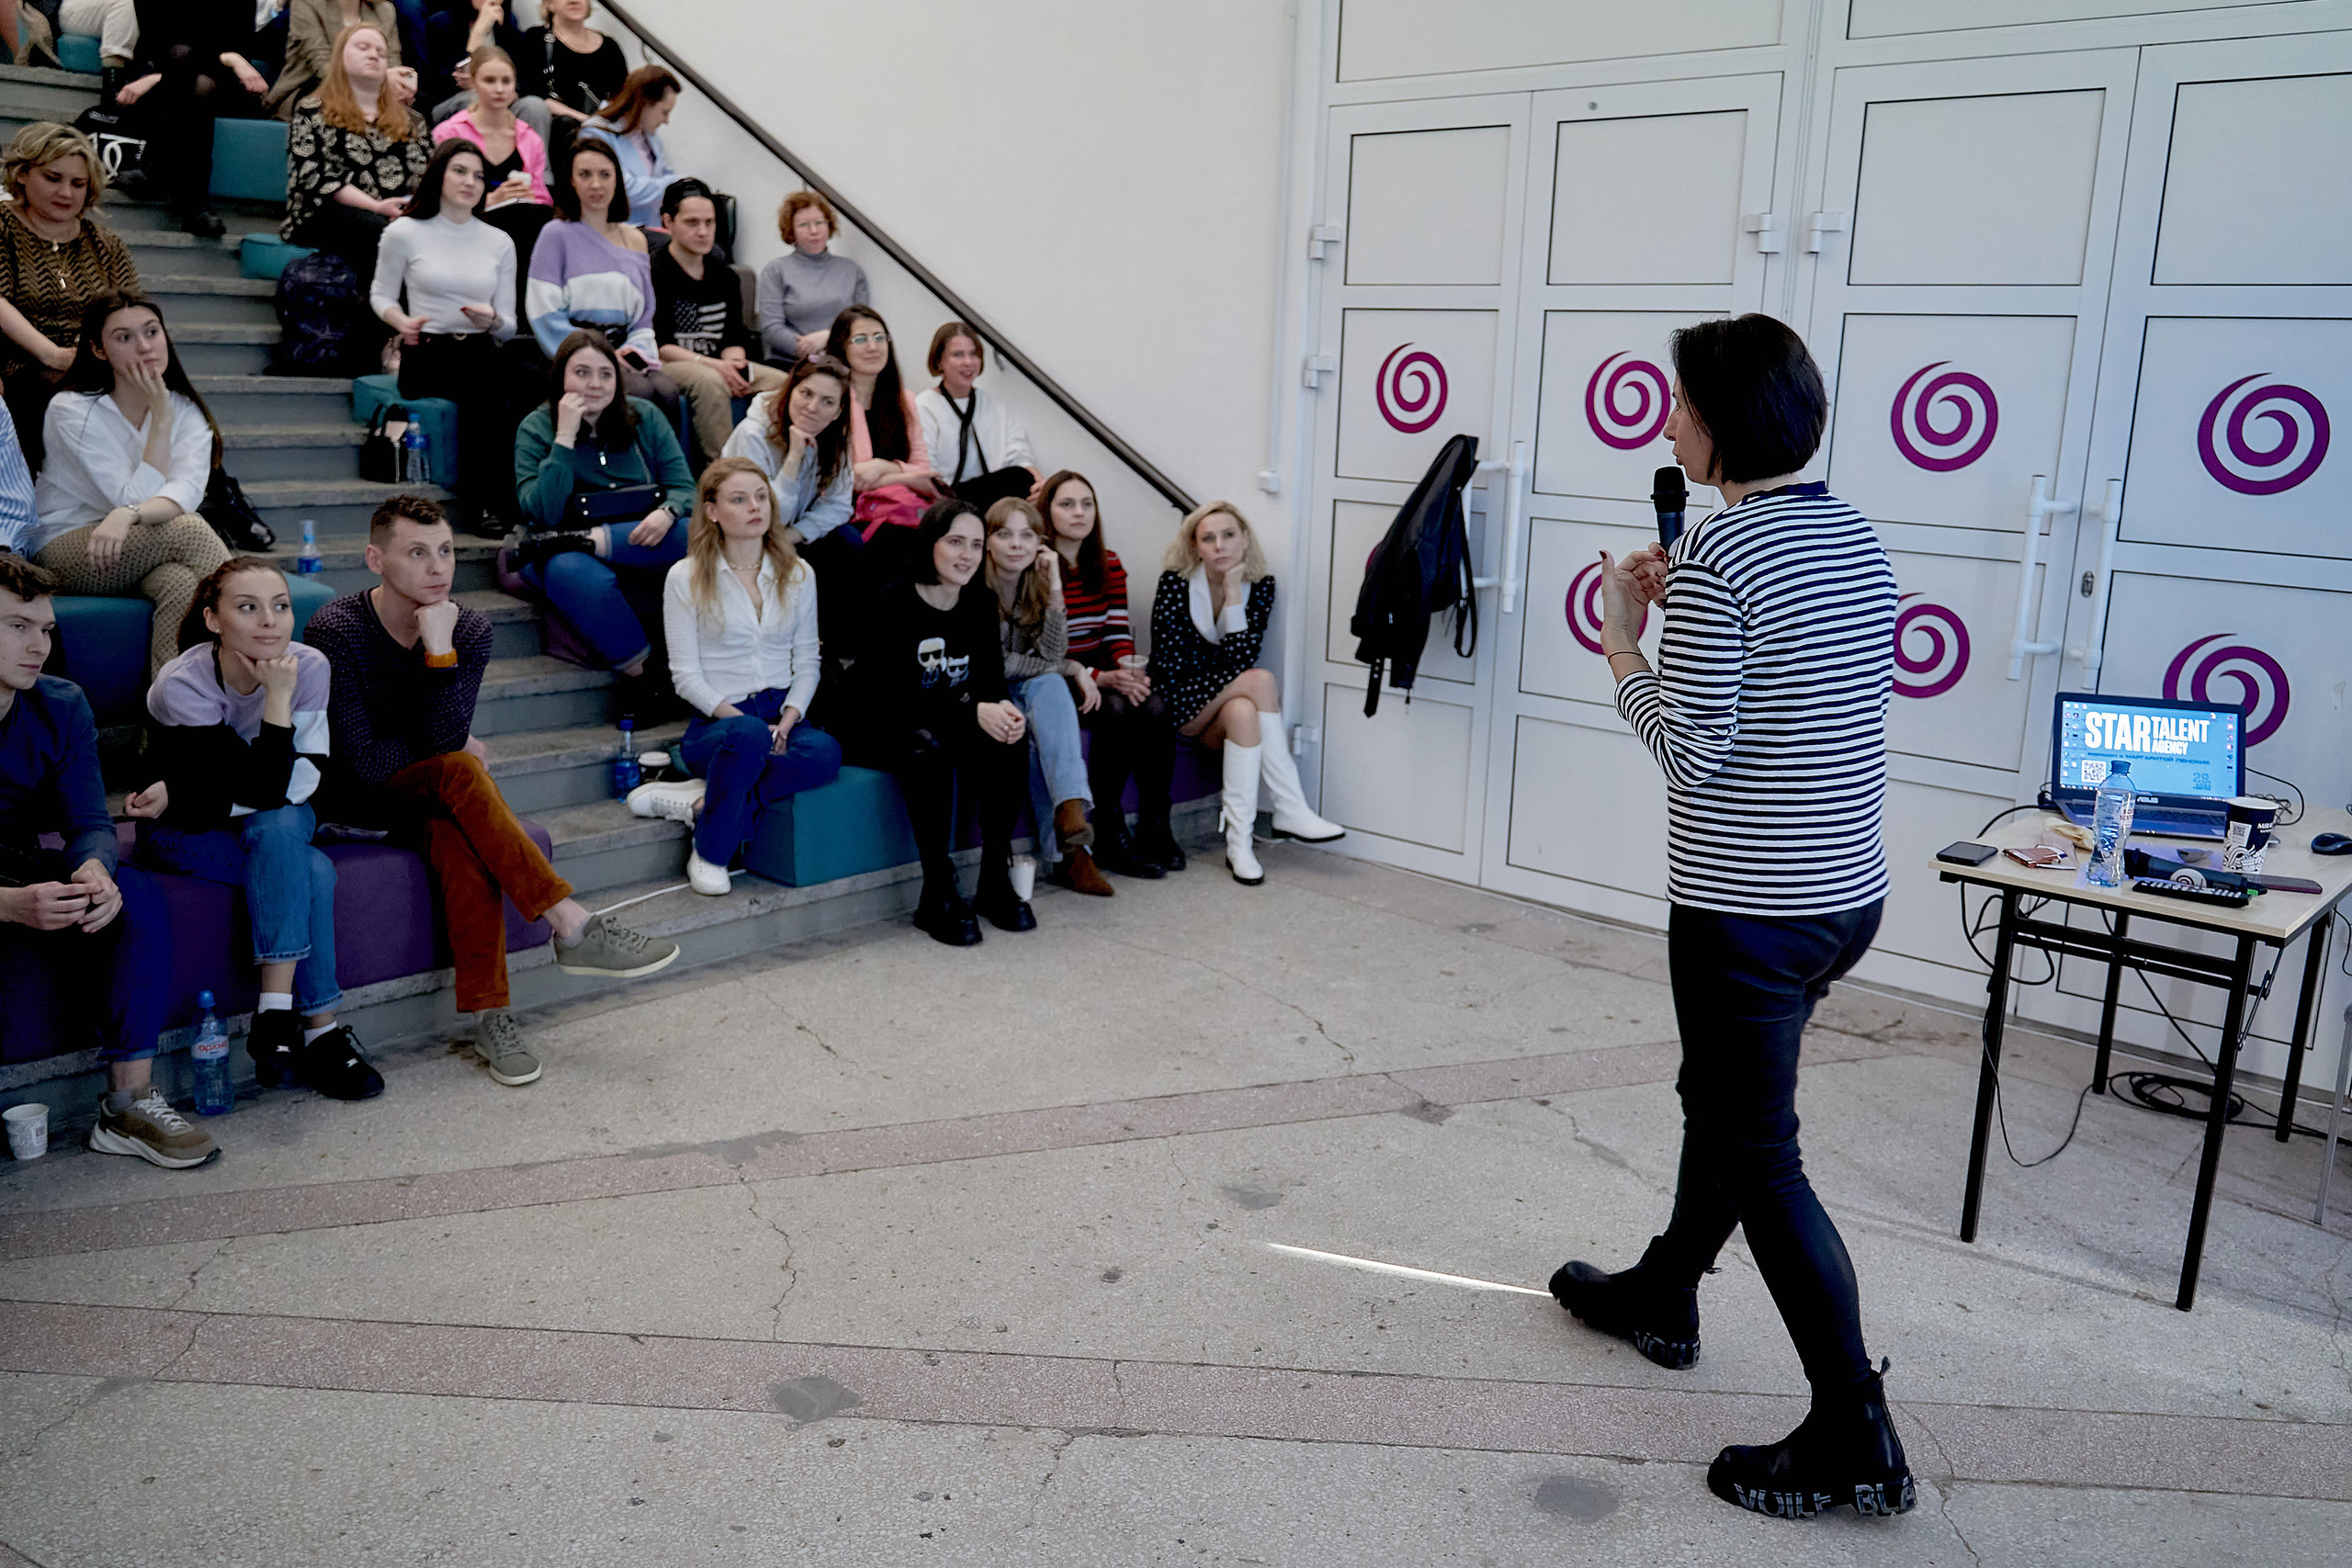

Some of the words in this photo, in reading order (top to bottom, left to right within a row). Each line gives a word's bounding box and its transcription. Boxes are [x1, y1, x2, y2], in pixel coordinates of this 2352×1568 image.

[2085, 711, 2151, 752] STAR
[2151, 716, 2211, 743] TALENT
[2152, 739, 2188, 756] AGENCY
[2137, 795, 2159, 804] ASUS
